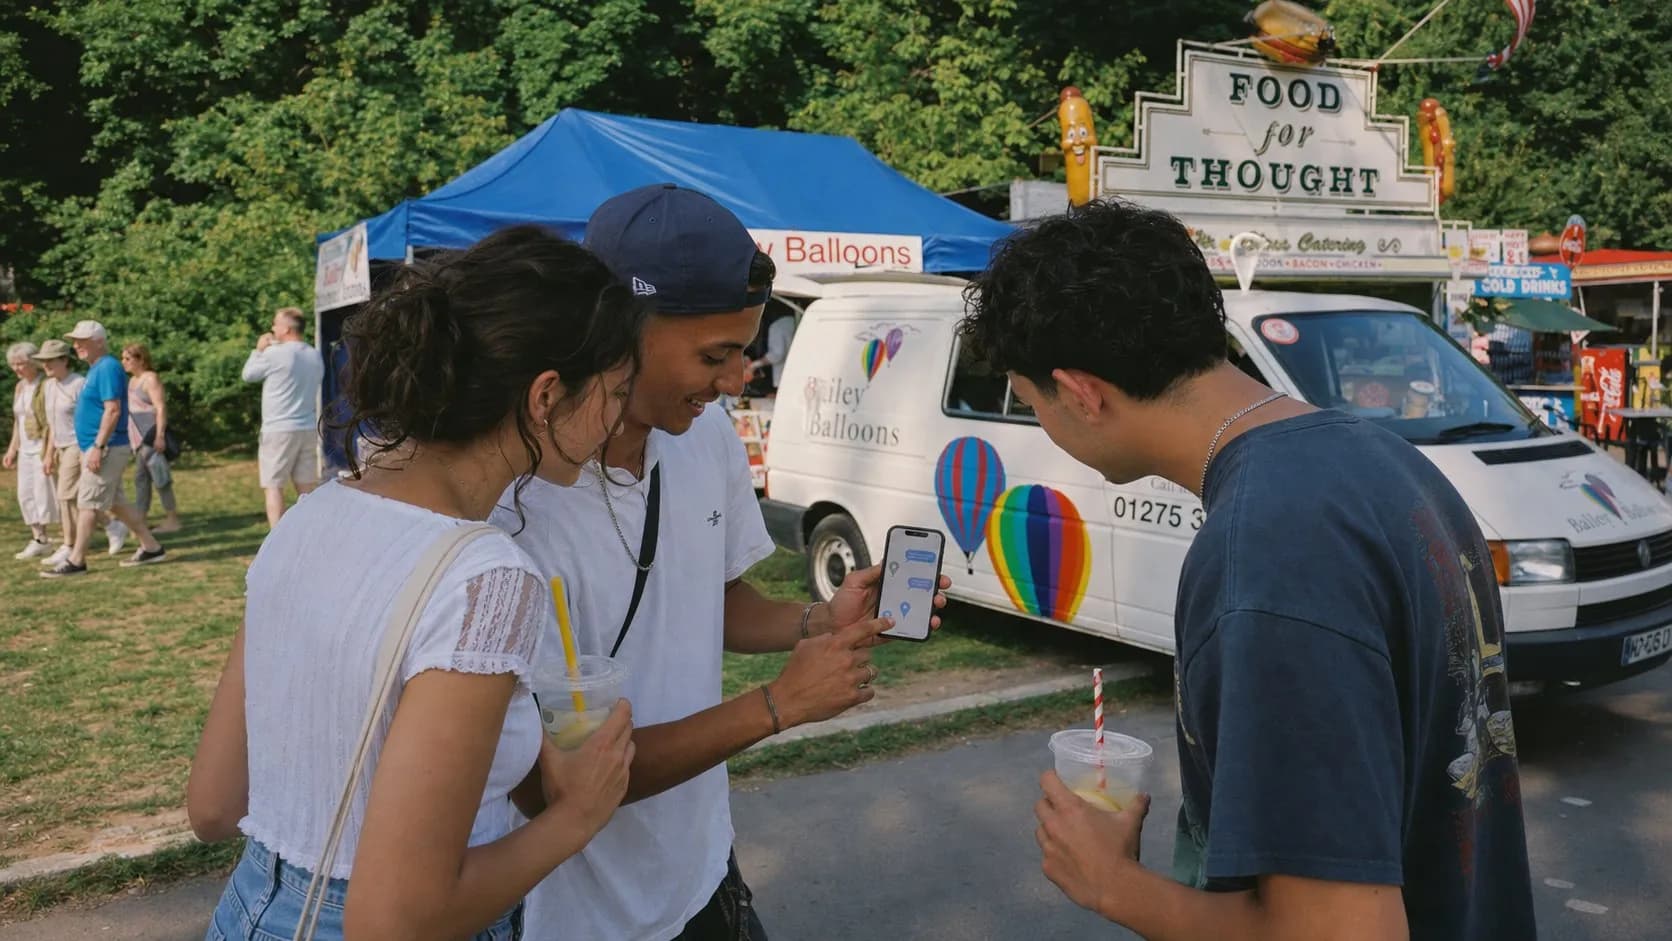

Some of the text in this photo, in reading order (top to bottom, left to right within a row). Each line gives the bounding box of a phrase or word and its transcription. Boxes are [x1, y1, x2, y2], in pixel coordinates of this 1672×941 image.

[1229, 73, 1343, 113] FOOD
[1253, 120, 1315, 156] for
[1170, 156, 1380, 197] THOUGHT
[785, 236, 912, 265] Balloons
[1297, 231, 1367, 255] Catering
[1481, 278, 1568, 296] COLD DRINKS
[809, 412, 901, 447] Balloons
[1114, 496, 1182, 528] 01275
